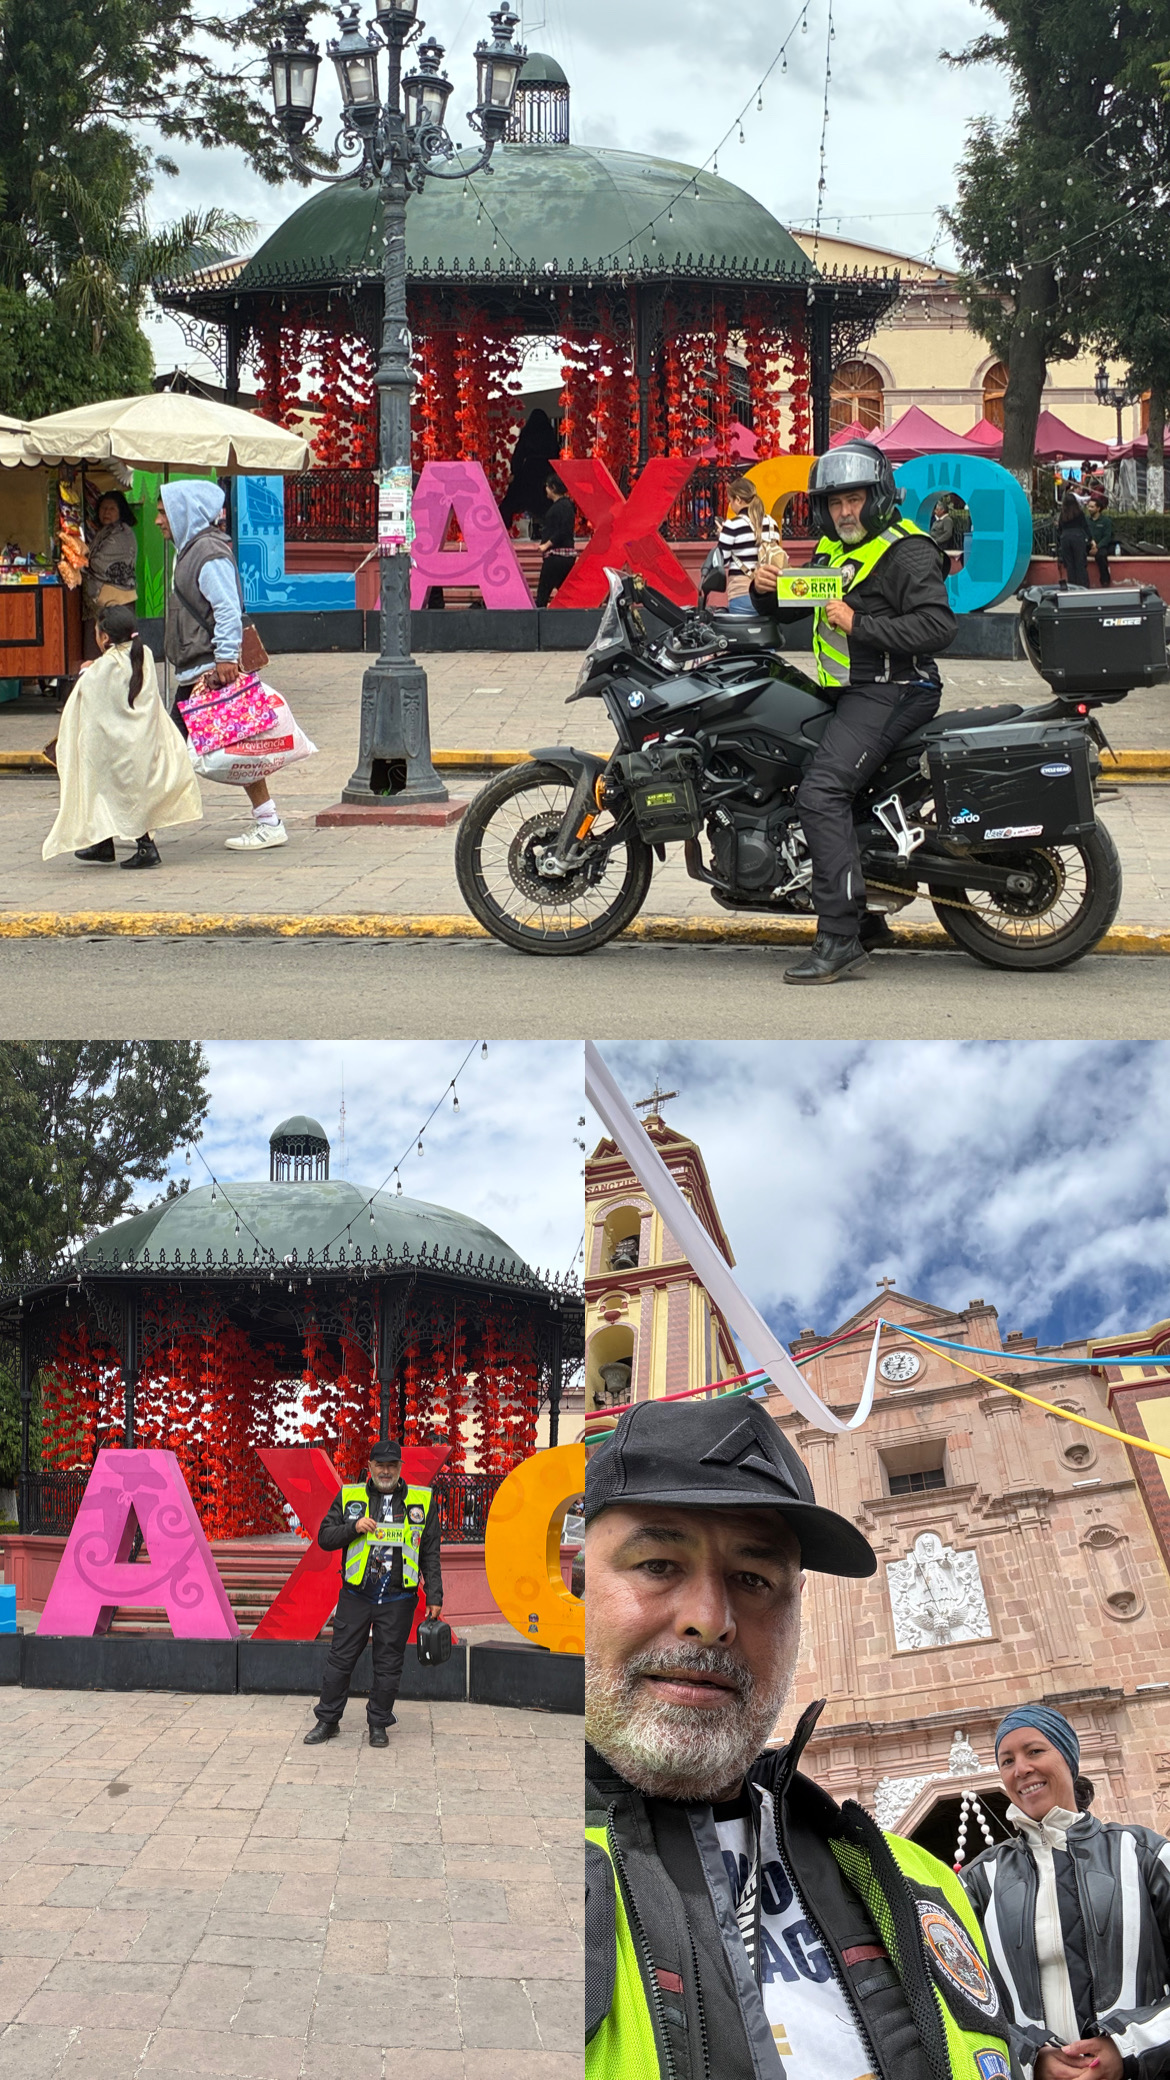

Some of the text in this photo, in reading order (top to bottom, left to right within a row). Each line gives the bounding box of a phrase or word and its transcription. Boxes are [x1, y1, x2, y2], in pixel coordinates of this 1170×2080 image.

[811, 583, 836, 593] RRM
[951, 812, 980, 824] cardo
[586, 1178, 637, 1193] SANCTUS
